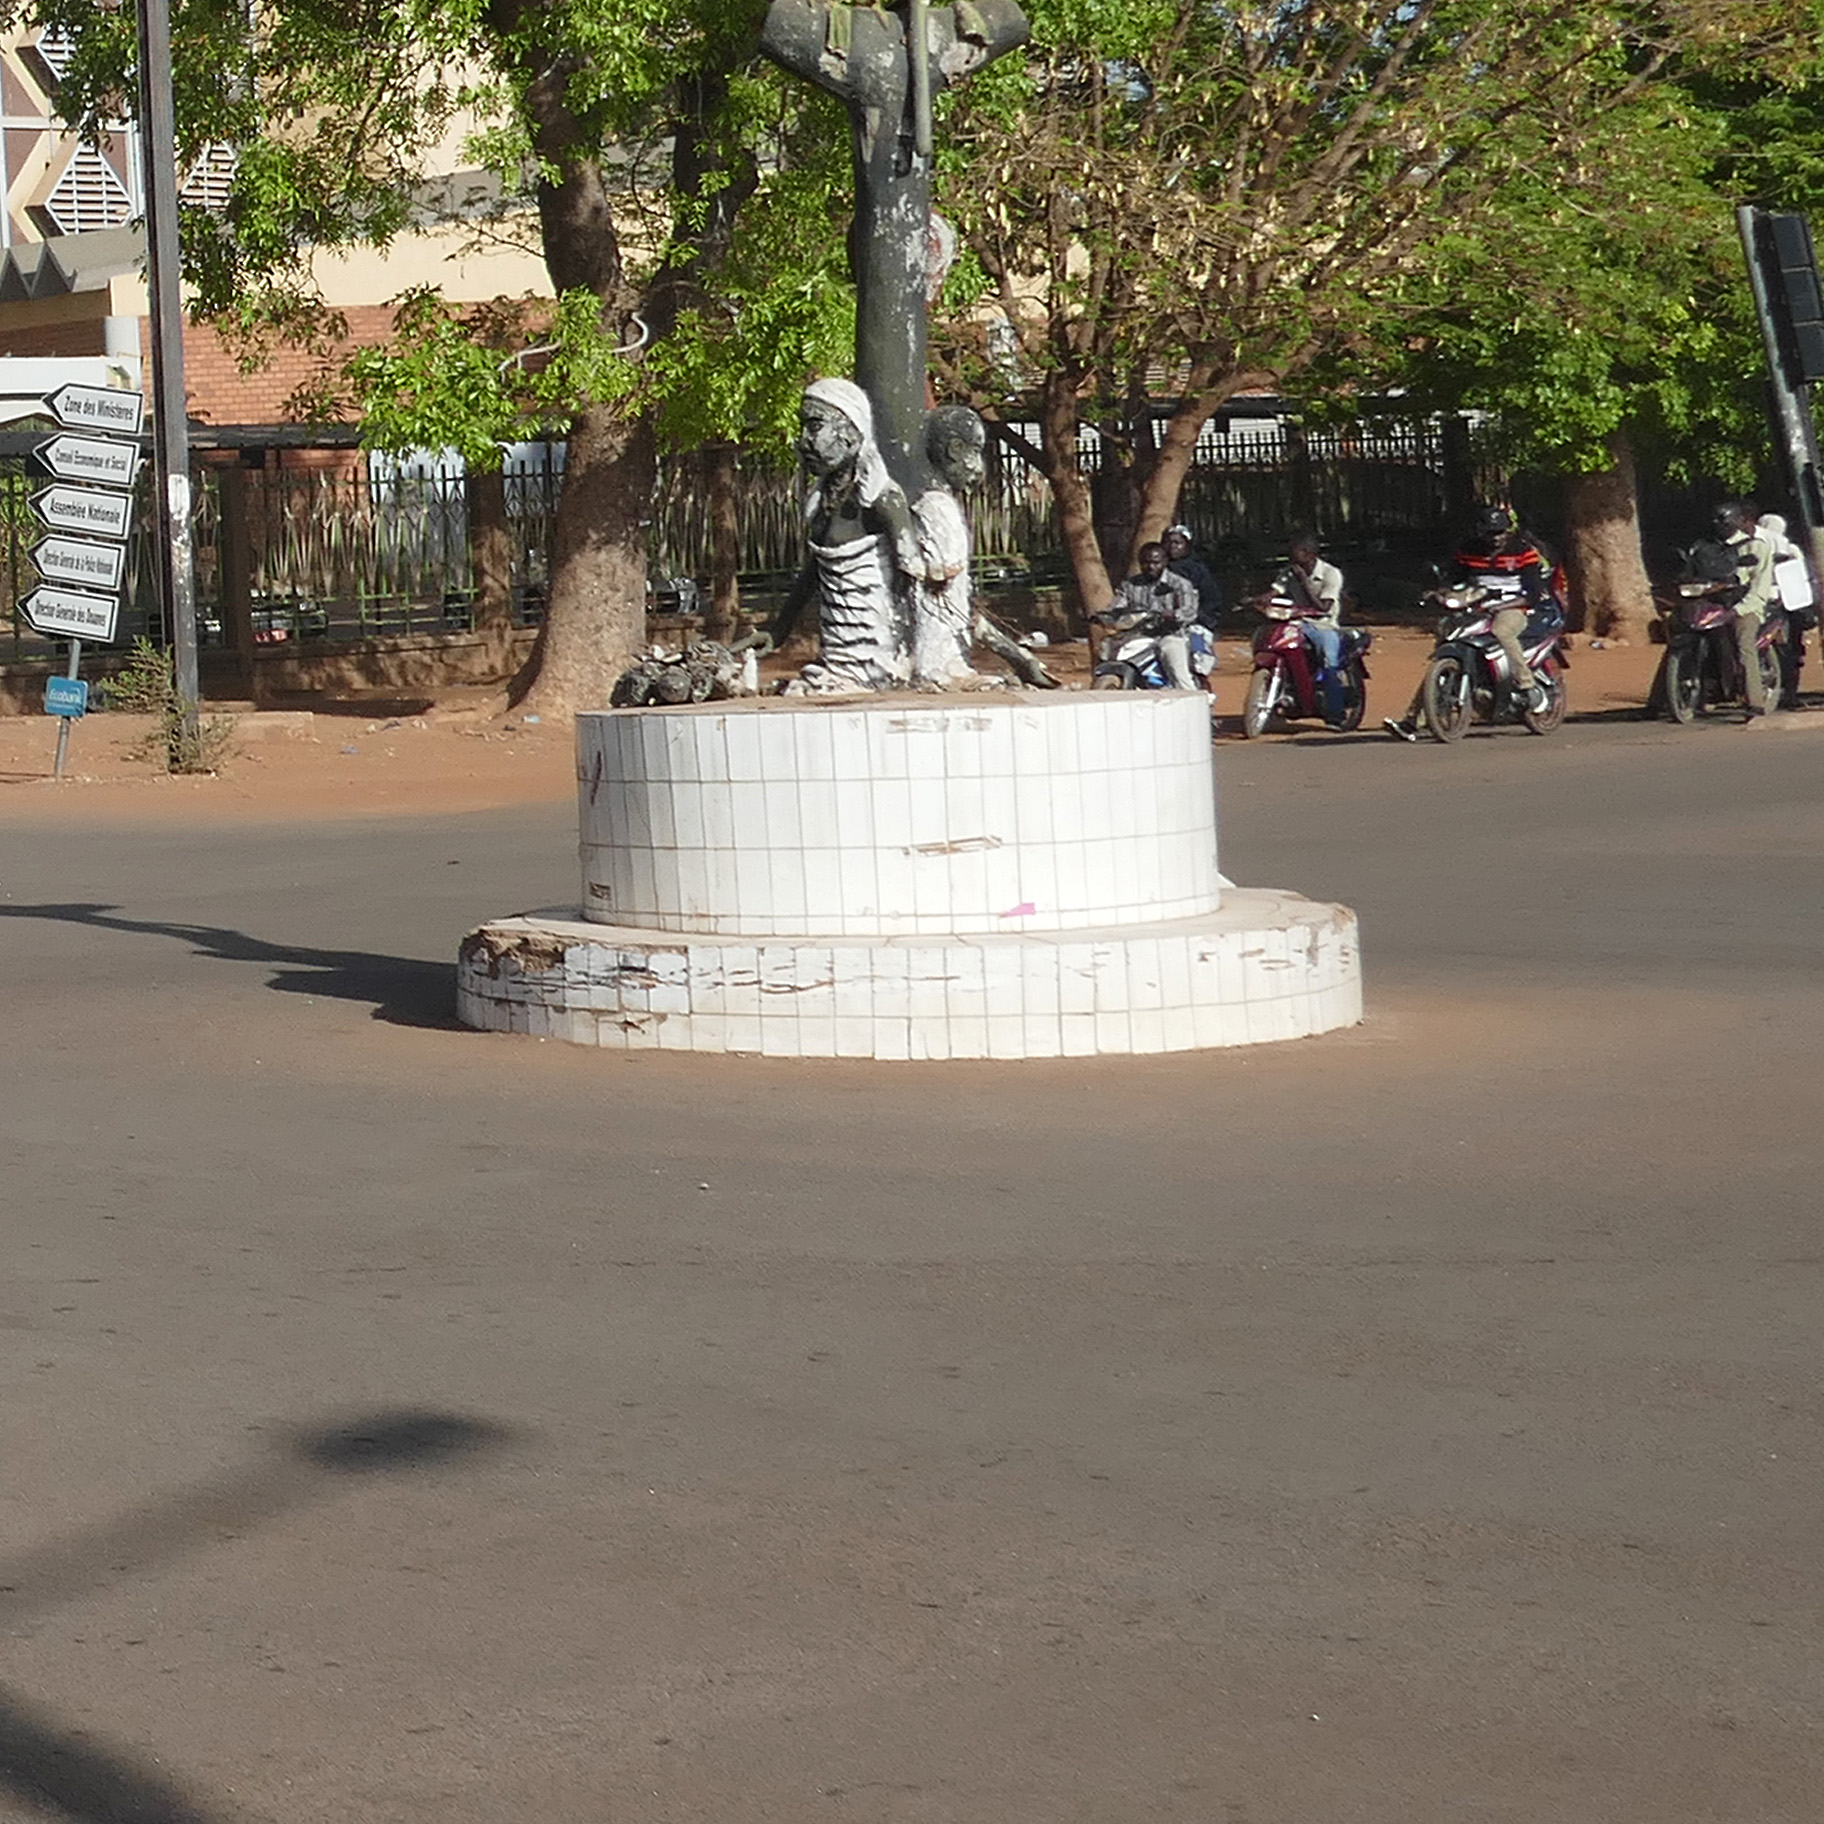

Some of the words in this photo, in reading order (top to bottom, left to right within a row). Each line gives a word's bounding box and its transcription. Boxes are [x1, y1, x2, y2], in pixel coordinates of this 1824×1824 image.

[64, 395, 82, 414] Zone
[83, 398, 96, 416] des
[49, 497, 87, 519] Assemblée
[88, 502, 121, 525] Nationale
